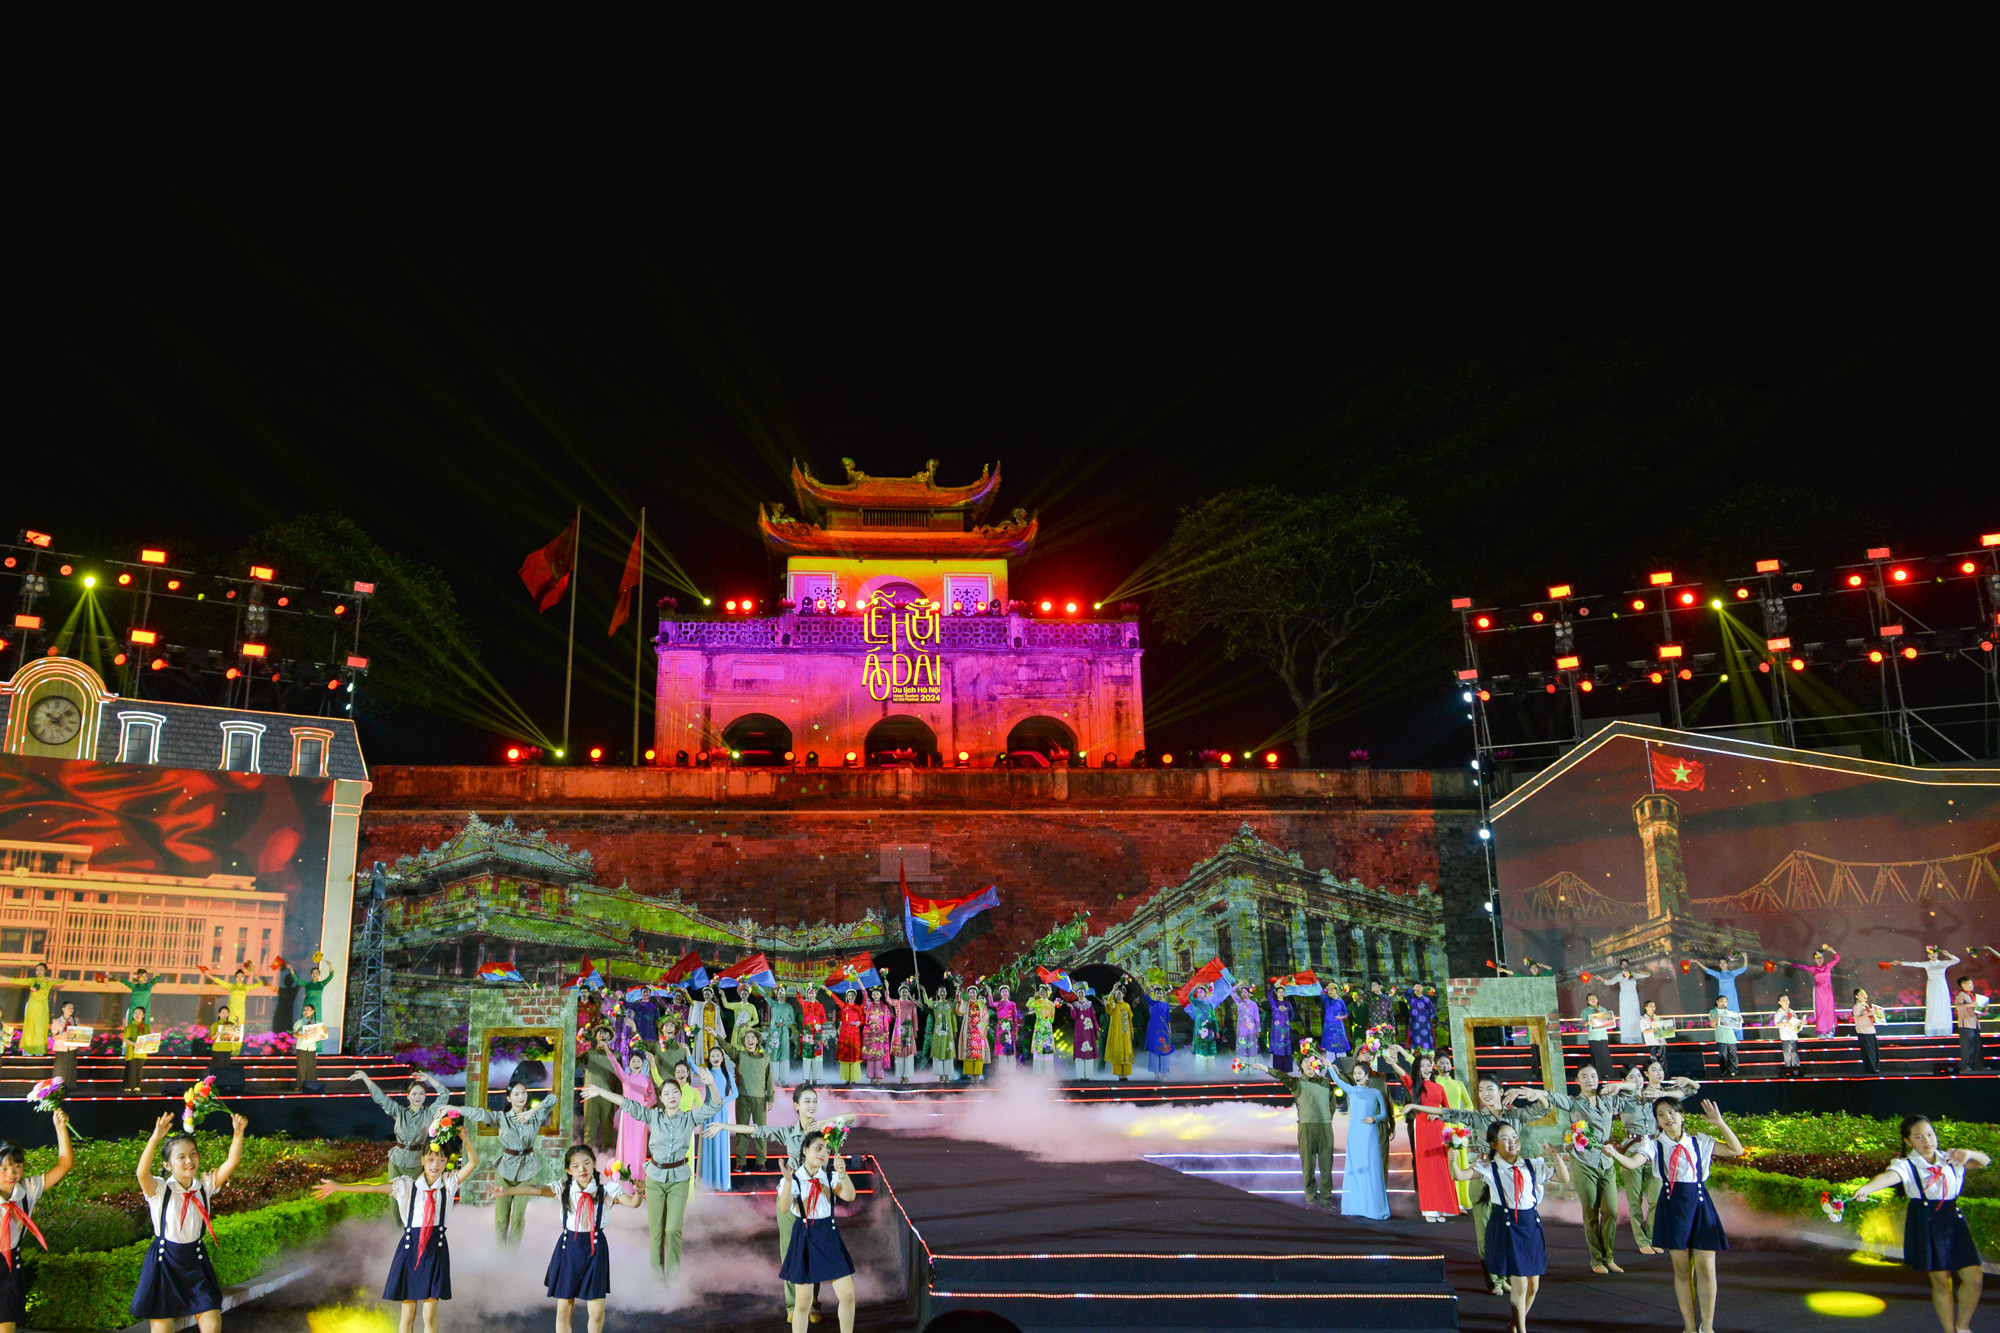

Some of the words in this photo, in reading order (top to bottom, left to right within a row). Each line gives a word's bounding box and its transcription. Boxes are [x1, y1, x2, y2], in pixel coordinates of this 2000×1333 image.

[864, 590, 895, 644] LỄ
[891, 598, 940, 652] HỘI
[862, 646, 891, 701] ÁO
